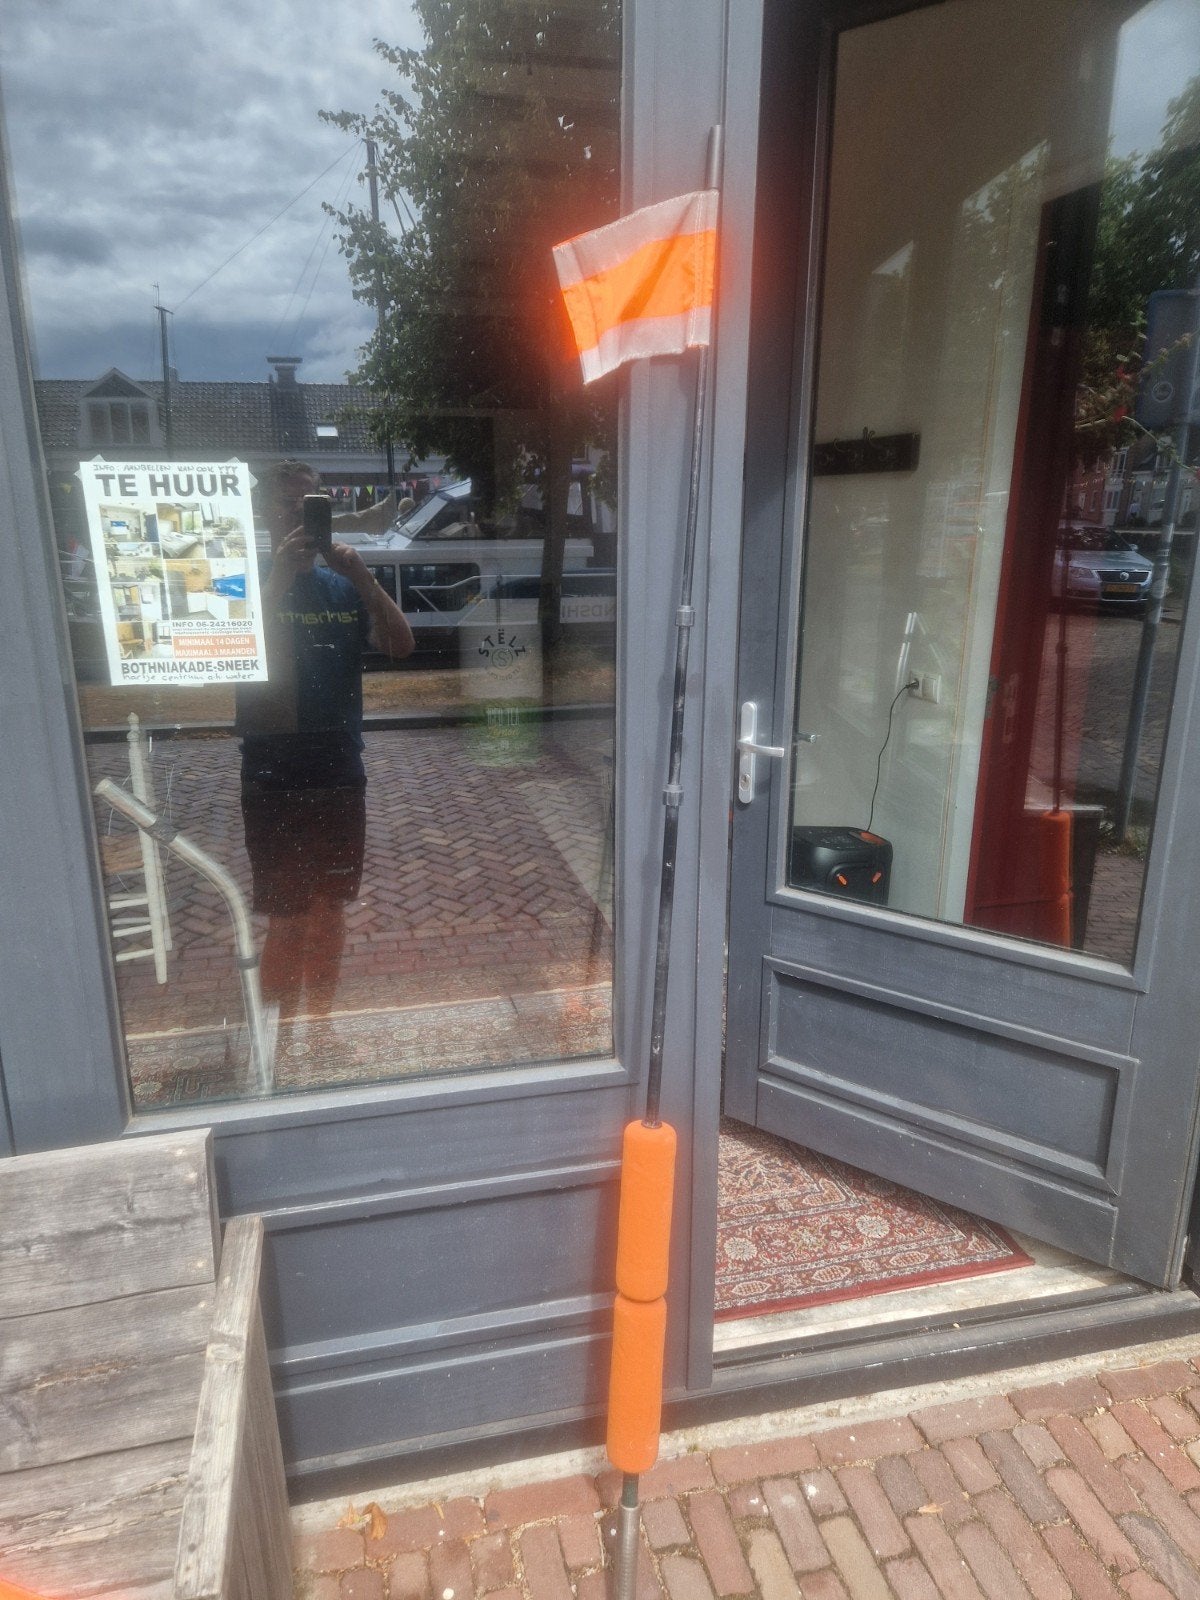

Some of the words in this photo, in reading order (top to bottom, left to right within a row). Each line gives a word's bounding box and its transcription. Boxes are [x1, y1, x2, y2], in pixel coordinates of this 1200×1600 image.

[95, 474, 138, 497] TE
[149, 474, 242, 497] HUUR
[195, 620, 253, 628] 06-24216020
[178, 637, 214, 647] MINIMAAL
[225, 636, 250, 646] DAGEN
[479, 629, 526, 657] STËLZ
[175, 648, 213, 657] MAXIMAAL
[219, 647, 256, 656] MAANDEN
[121, 659, 260, 675] BOTHNIAKADE-SNEEK
[225, 671, 255, 681] water
